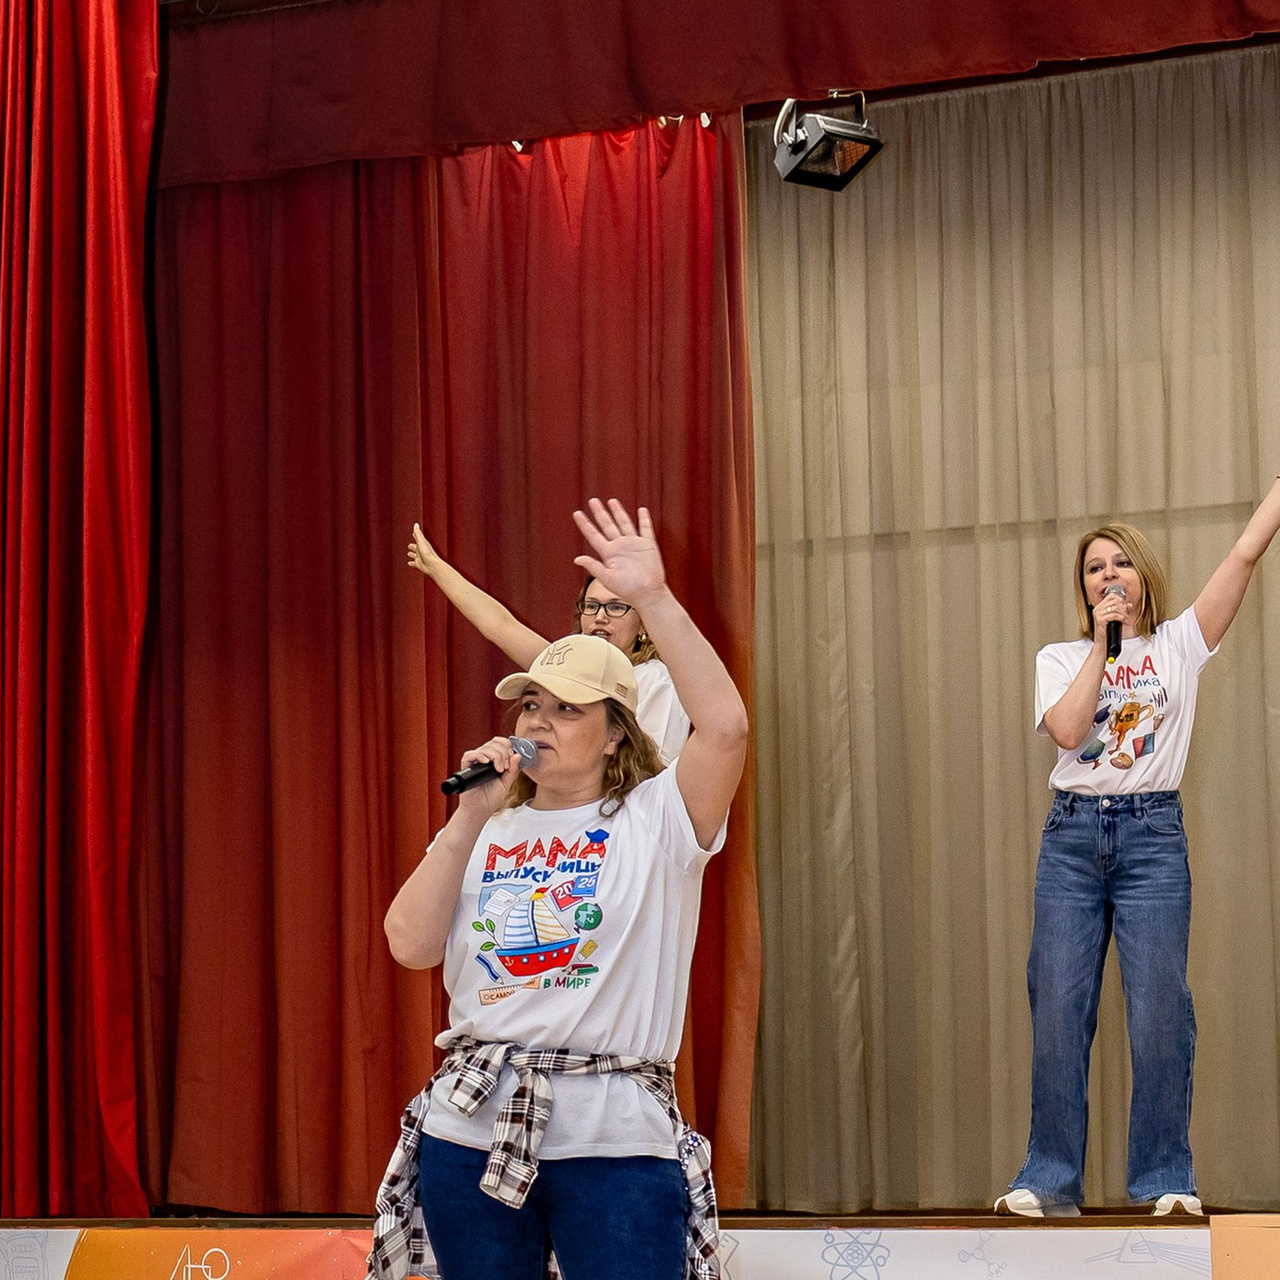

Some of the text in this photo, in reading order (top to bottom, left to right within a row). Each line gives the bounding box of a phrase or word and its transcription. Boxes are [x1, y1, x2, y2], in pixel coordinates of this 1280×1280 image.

[485, 835, 607, 871] МАМА
[578, 876, 596, 888] 25
[543, 979, 551, 989] В
[555, 977, 591, 989] МИРЕ
